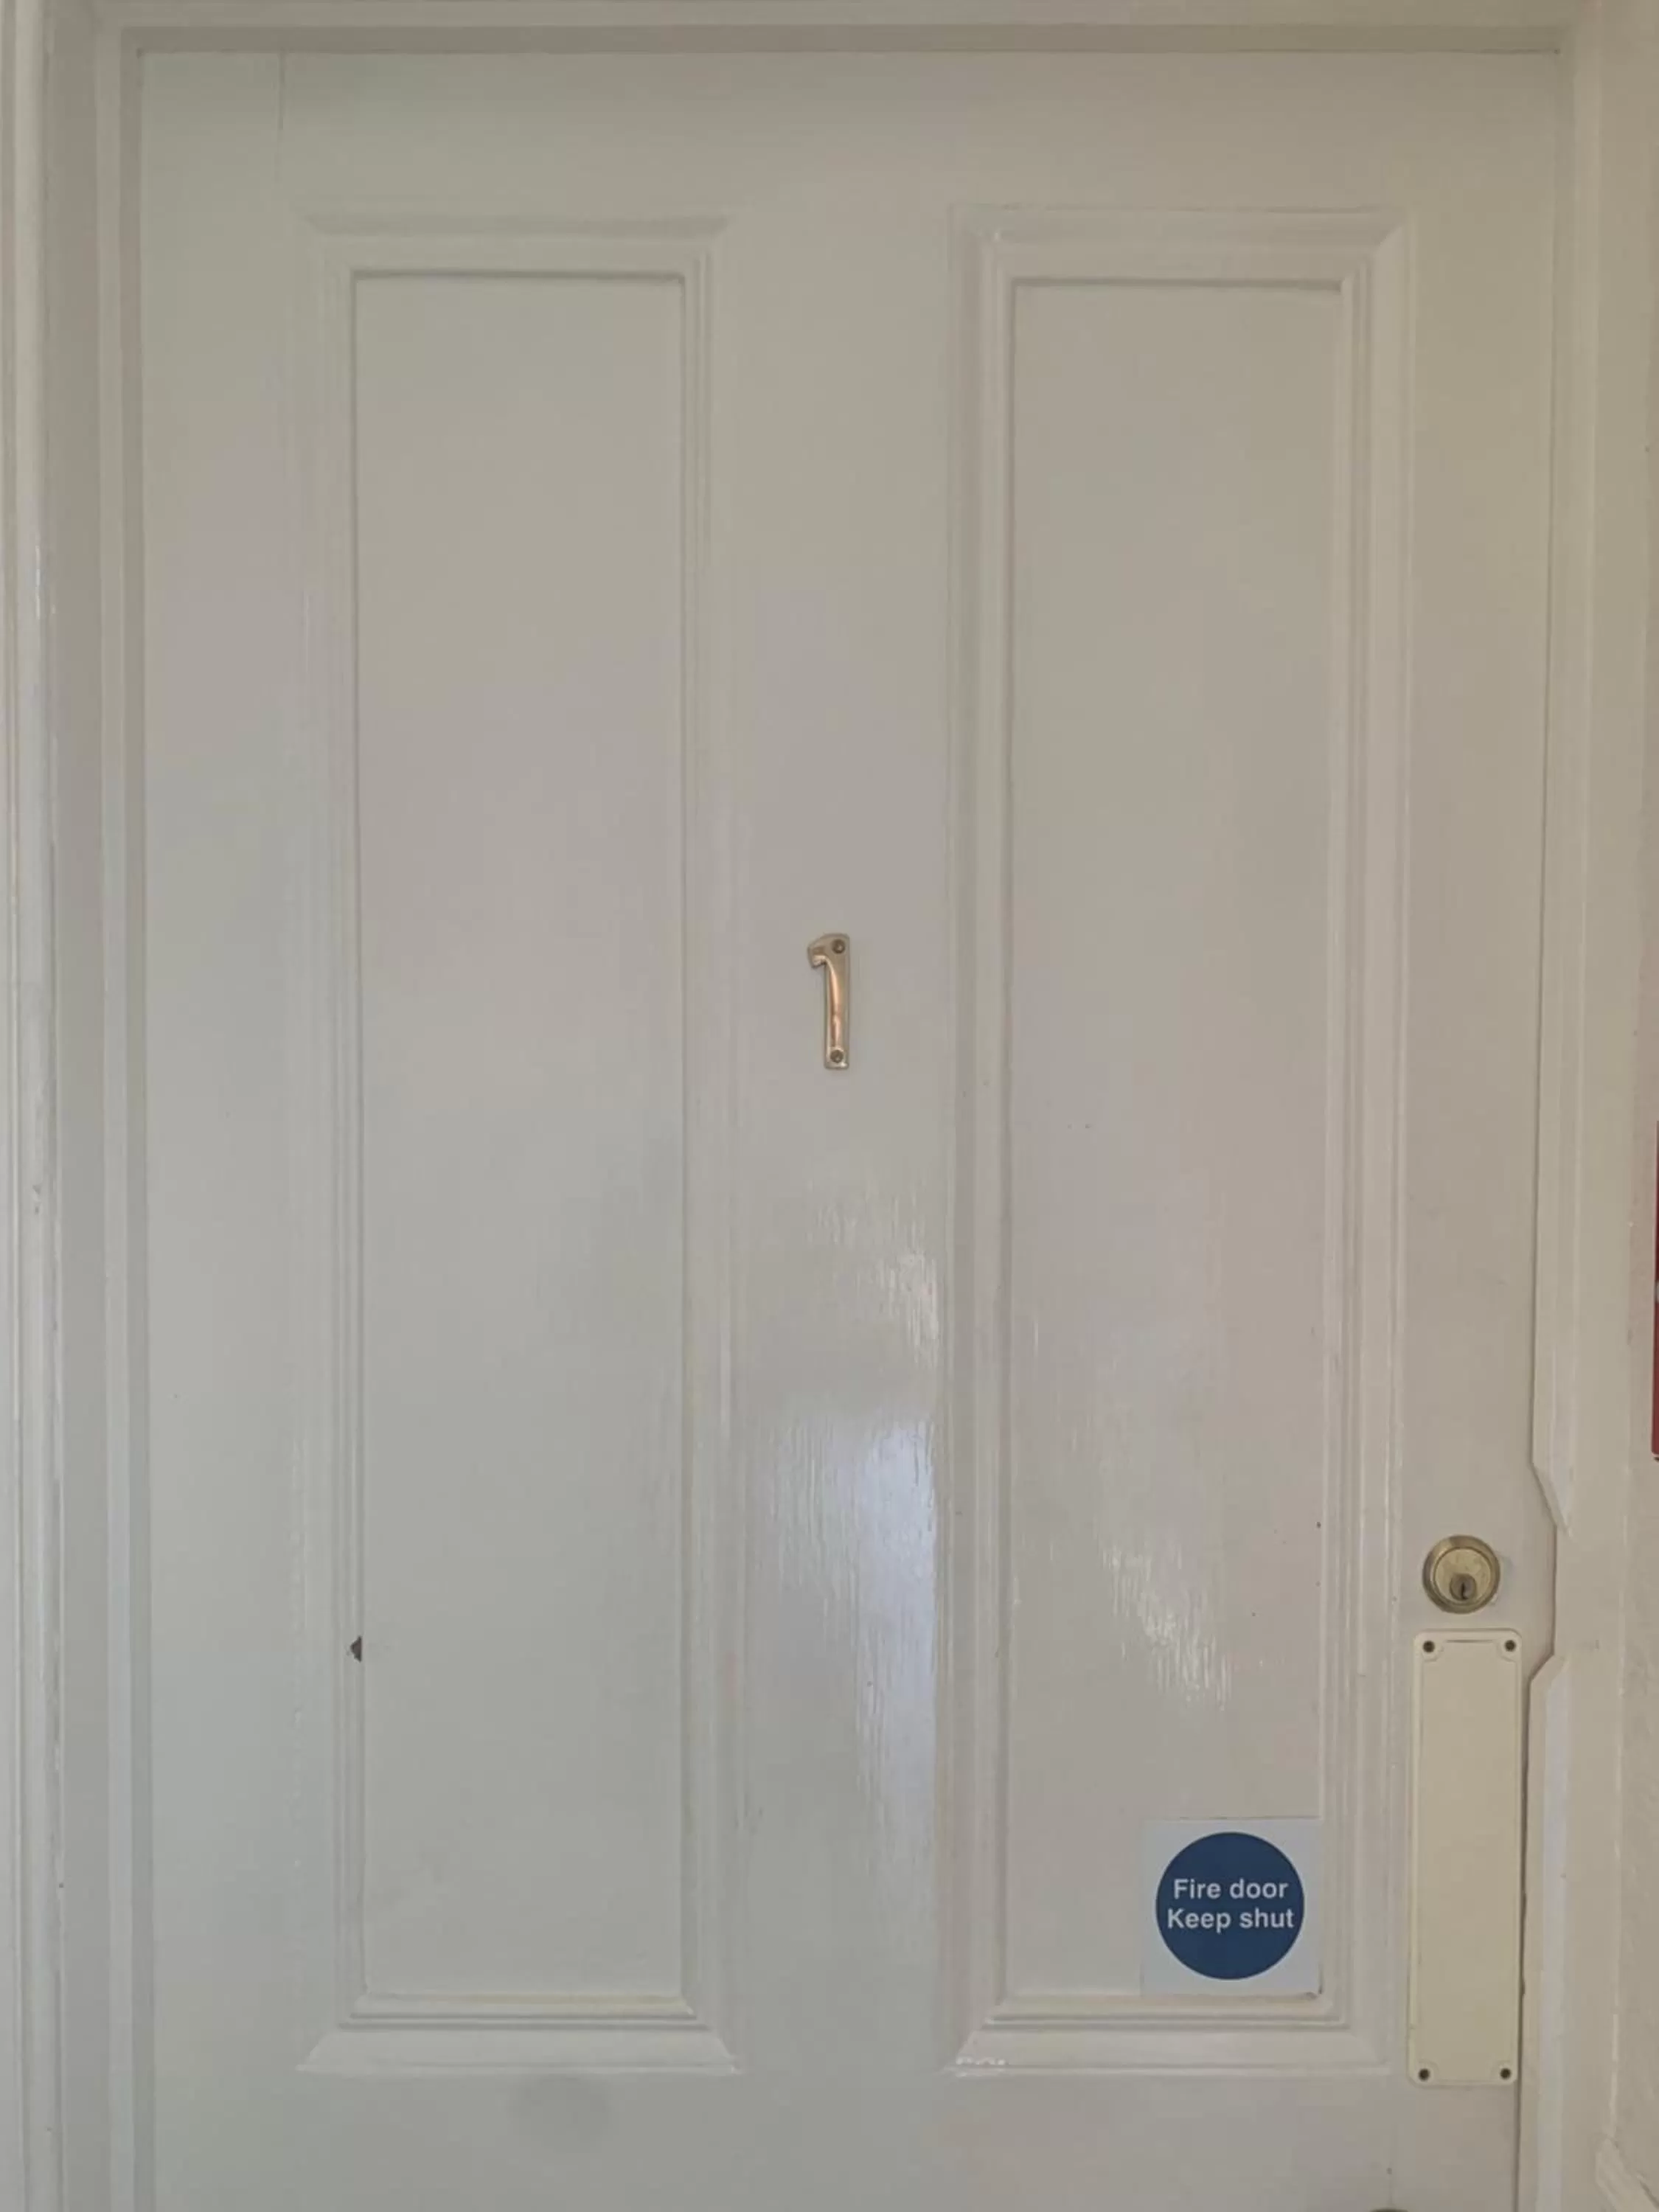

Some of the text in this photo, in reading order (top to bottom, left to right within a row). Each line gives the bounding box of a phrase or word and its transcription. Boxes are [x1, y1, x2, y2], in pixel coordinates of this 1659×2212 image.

[807, 933, 849, 1069] 1
[1174, 1877, 1289, 1899] Fire door
[1167, 1907, 1295, 1934] Keep shut
